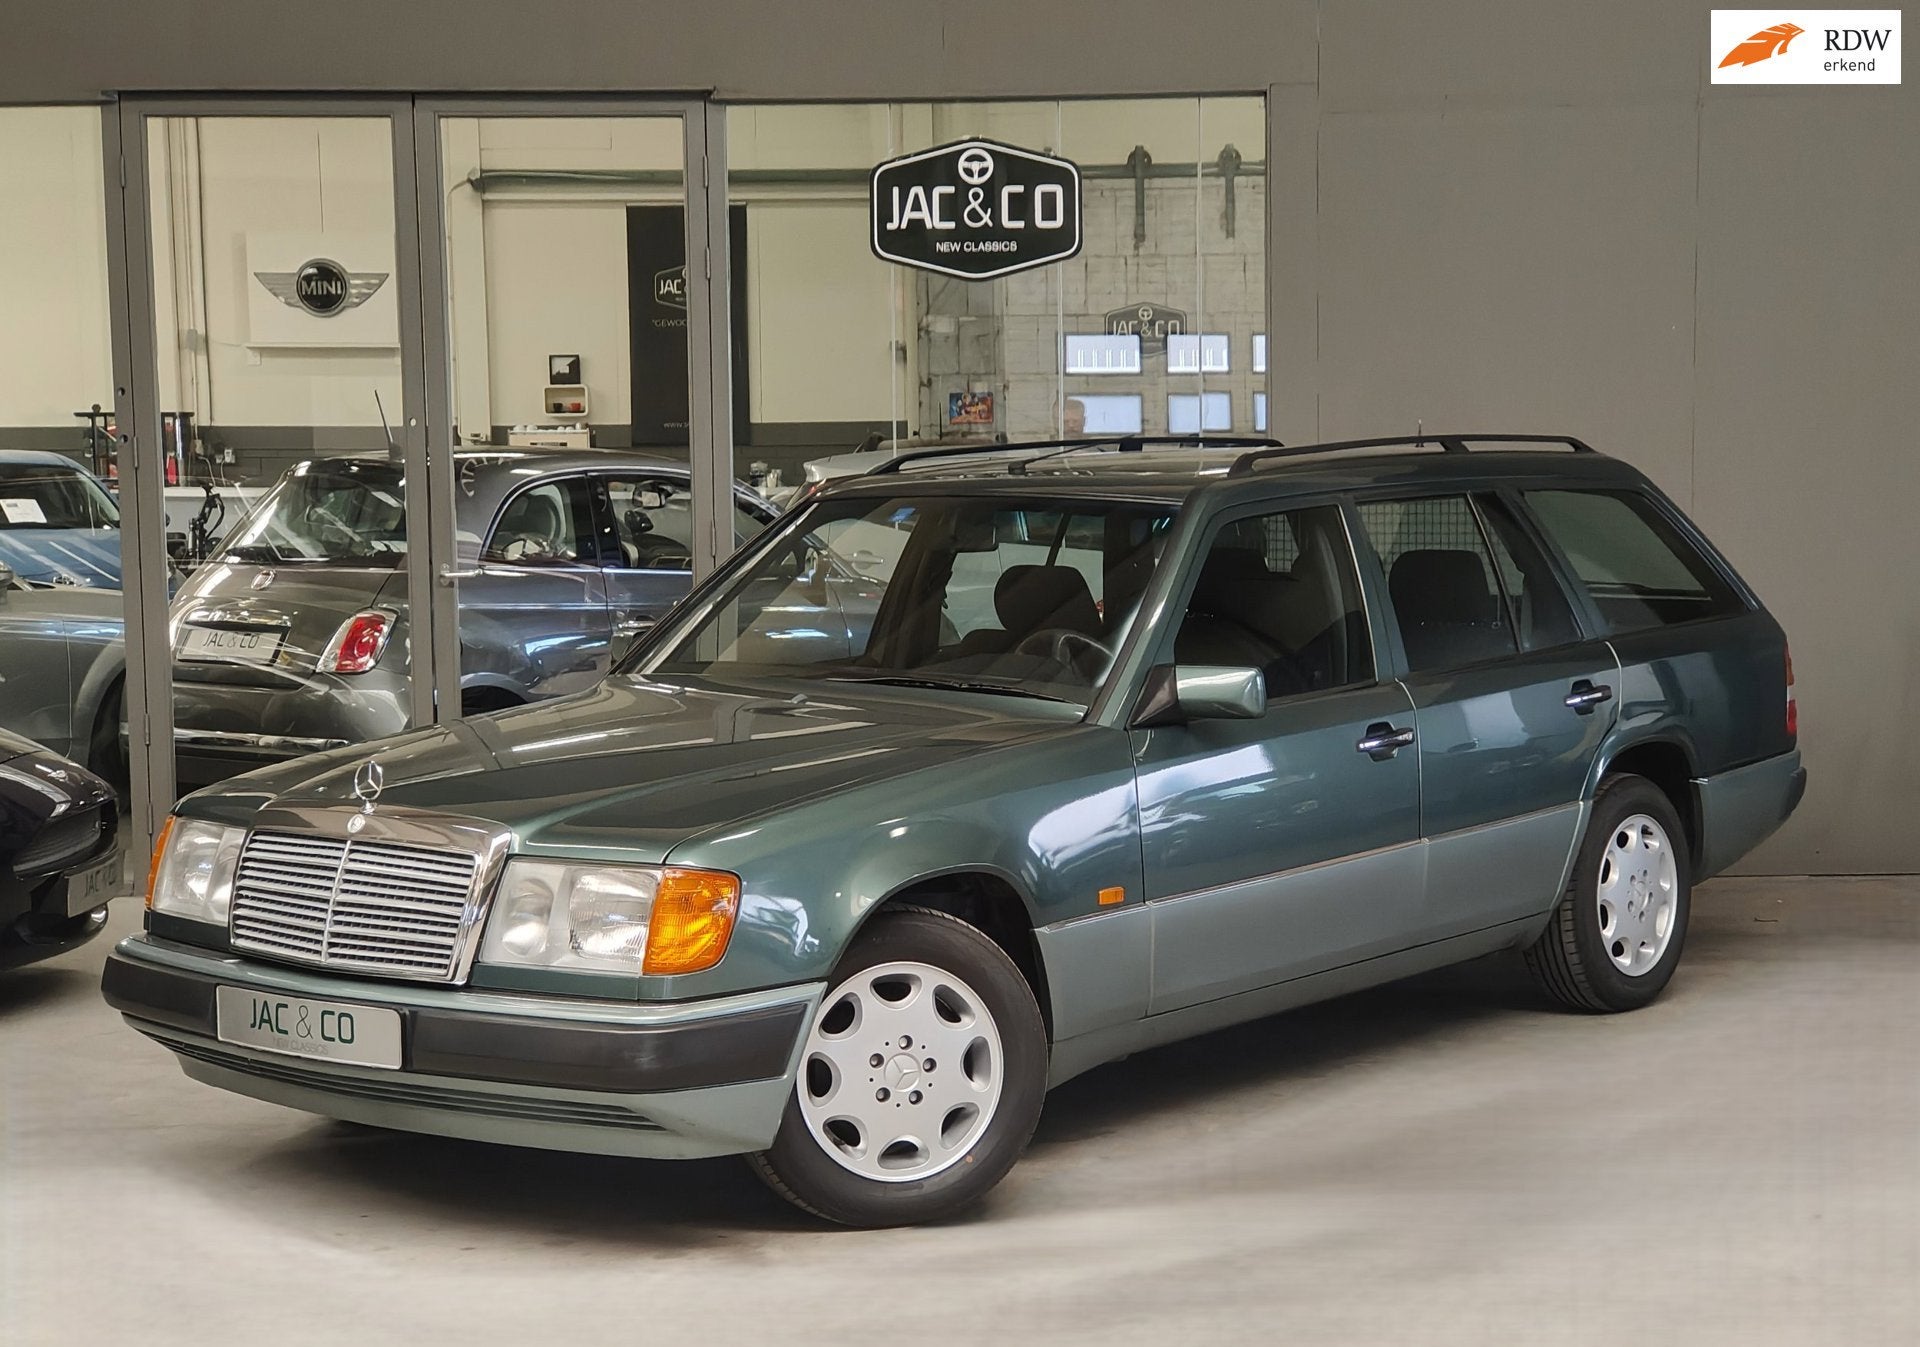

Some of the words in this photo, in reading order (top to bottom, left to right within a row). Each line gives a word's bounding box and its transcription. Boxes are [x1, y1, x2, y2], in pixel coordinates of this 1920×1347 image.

[886, 185, 956, 231] JAC
[963, 187, 993, 228] &
[936, 241, 961, 253] NEW
[963, 240, 1017, 253] CLASSICS
[301, 279, 343, 295] MINI
[659, 279, 682, 295] JAC
[250, 999, 289, 1035] JAC
[295, 1005, 313, 1039] &
[321, 1010, 355, 1044] CO
